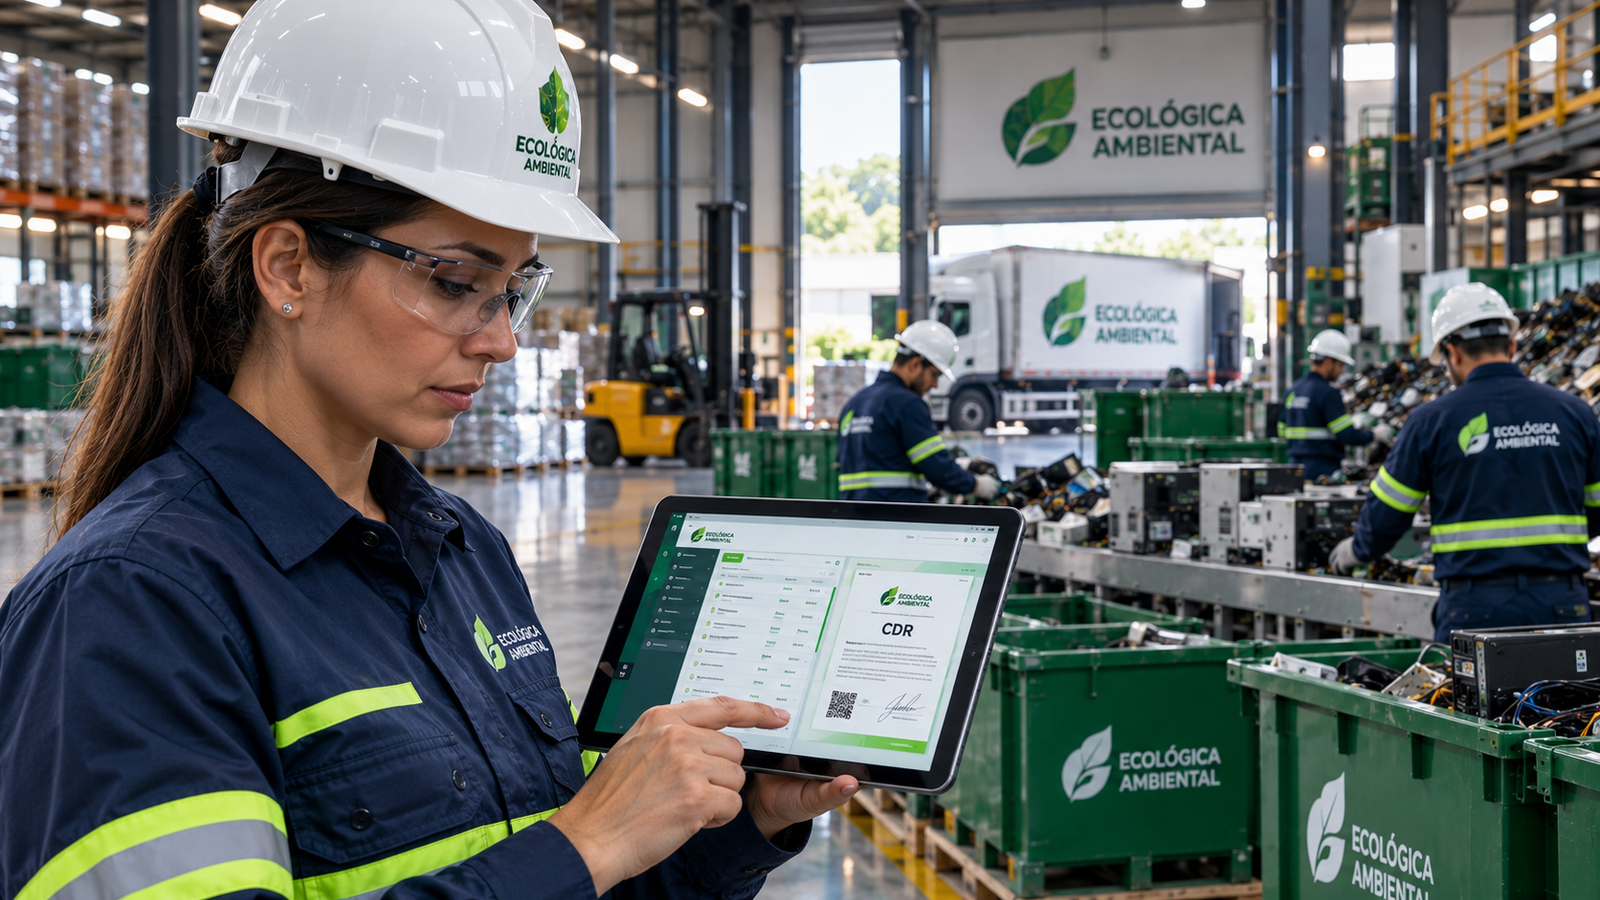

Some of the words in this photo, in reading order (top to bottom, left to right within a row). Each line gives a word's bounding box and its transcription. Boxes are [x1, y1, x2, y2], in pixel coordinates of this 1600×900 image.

[1092, 99, 1245, 131] ECOLÓGICA
[516, 135, 576, 164] ECOLÓGICA
[1092, 132, 1245, 158] AMBIENTAL
[523, 158, 571, 179] AMBIENTAL
[1095, 301, 1177, 323] ECOLÓGICA
[1095, 327, 1177, 344] AMBIENTAL
[1493, 421, 1560, 438] ECOLÓGICA
[1495, 435, 1560, 450] AMBIENTAL
[882, 622, 914, 637] CDR
[1119, 744, 1221, 770] ECOLÓGICA
[1119, 769, 1221, 792] AMBIENTAL
[1352, 824, 1434, 885] ECOLÓGICA
